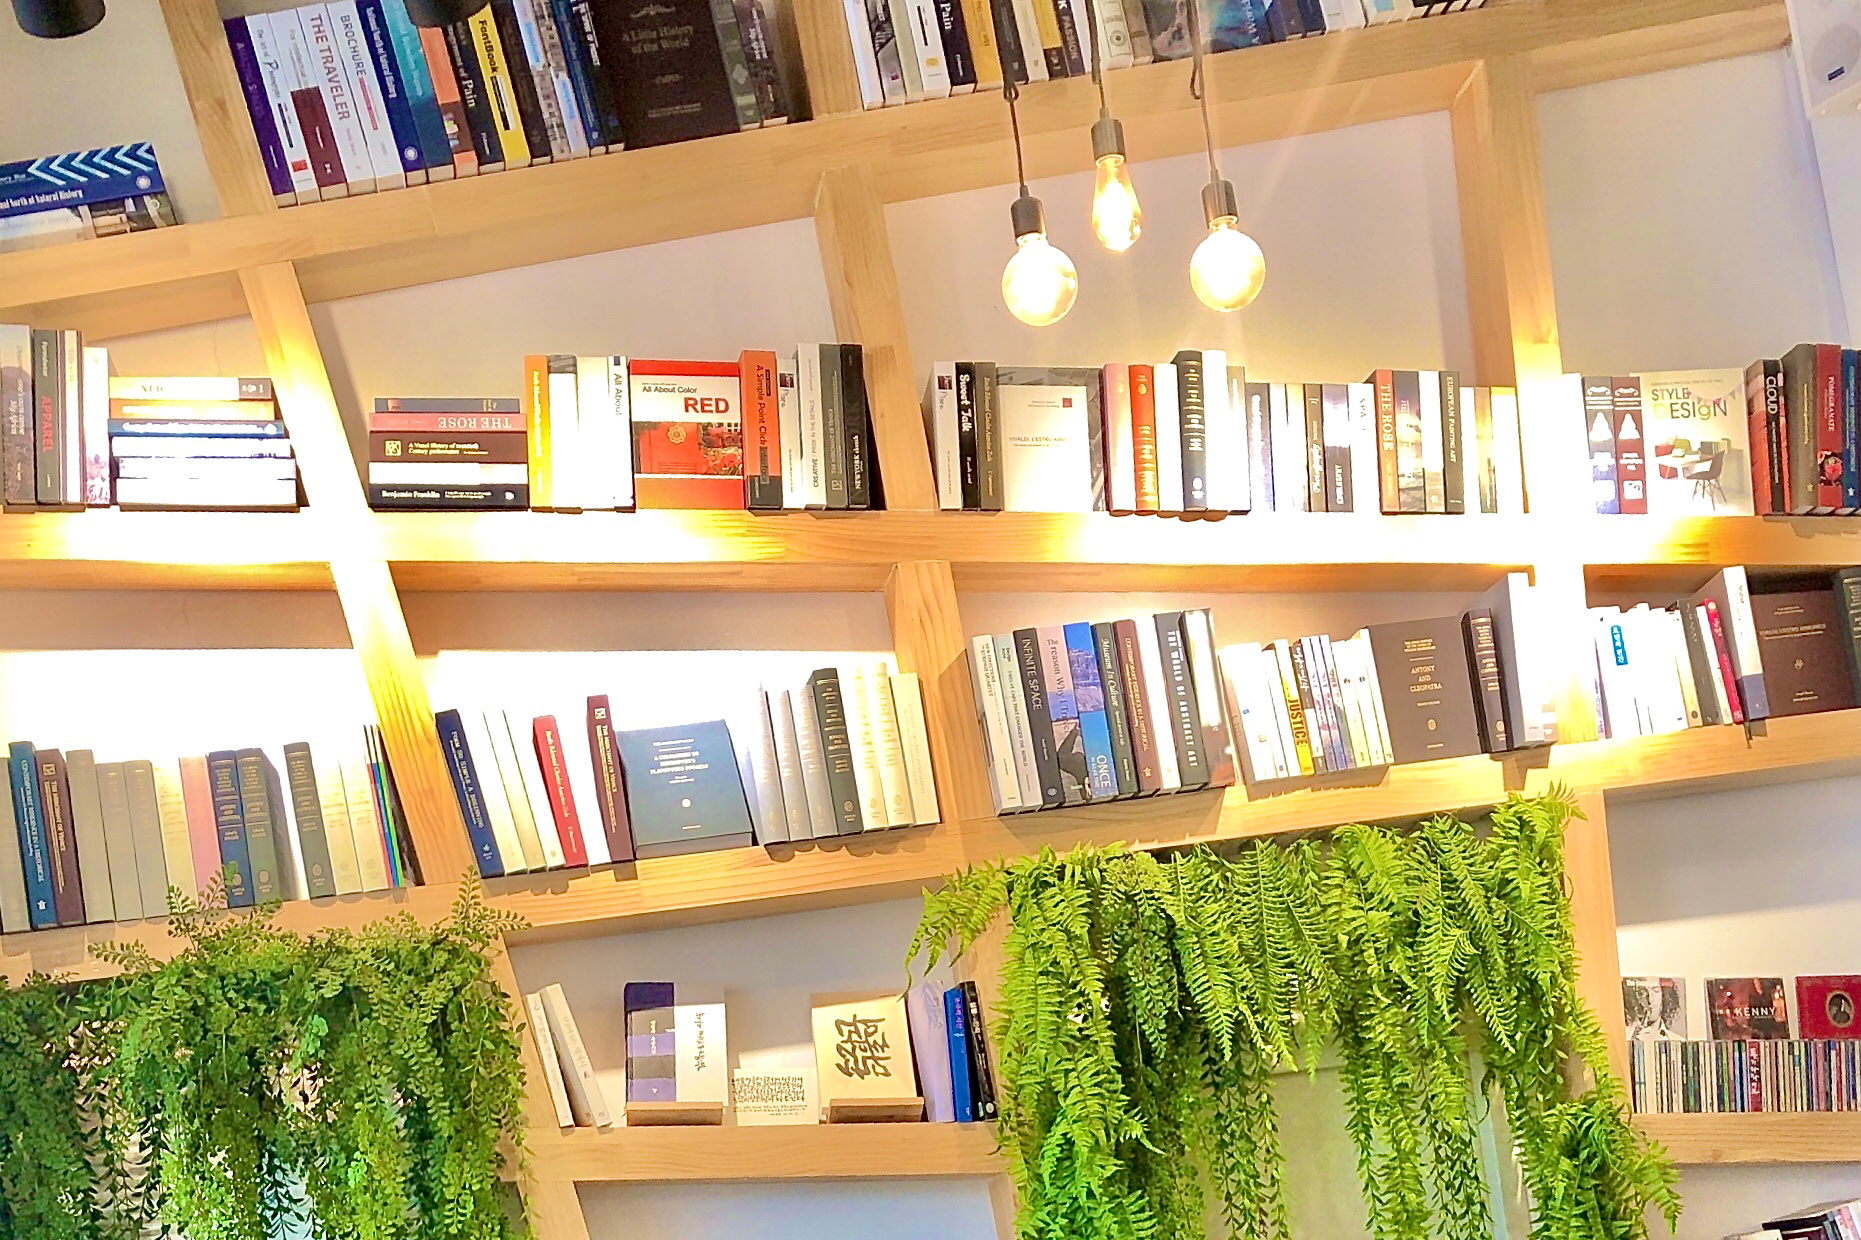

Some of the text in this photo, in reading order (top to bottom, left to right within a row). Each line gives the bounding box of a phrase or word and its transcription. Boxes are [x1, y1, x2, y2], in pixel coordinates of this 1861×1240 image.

[940, 4, 952, 30] Pain
[341, 15, 366, 76] BROCHURE
[1062, 15, 1079, 60] PASSION
[310, 14, 351, 121] THE TRAVELER
[462, 80, 476, 107] Pain
[755, 364, 763, 372] A
[612, 372, 623, 416] All About
[655, 385, 676, 393] About
[677, 386, 697, 394] Color
[753, 373, 765, 401] Simple
[957, 373, 973, 432] Sweet Talk
[1445, 376, 1454, 416] EUROPEAN
[1651, 386, 1690, 401] STYLE
[1764, 375, 1779, 414] CLOUD
[683, 395, 730, 416] RED
[756, 401, 766, 424] Point
[1379, 383, 1394, 451] THE ROSE
[1823, 376, 1839, 431] POMEGRANATE
[41, 395, 54, 453] APPAREL
[437, 416, 512, 429] THE ROSE
[757, 425, 767, 445] Click
[1447, 417, 1456, 449] PAINTING
[810, 457, 820, 488] CREATIVE
[381, 490, 413, 500] Benjamin
[413, 490, 441, 499] Franklin
[1021, 638, 1042, 710] INFINITE SPACE
[1050, 646, 1062, 674] reason
[1100, 637, 1120, 707] Museum In Culture
[1410, 664, 1435, 673] ANTONY
[1051, 676, 1066, 698] Why
[1409, 681, 1442, 692] CLEOPATRA
[1417, 673, 1431, 682] AND
[1167, 630, 1198, 767] THE WORLD OF ABSTRACT ART
[601, 724, 609, 735] THE
[1007, 670, 1015, 688] TWELVE
[1020, 749, 1028, 767] WORLD
[1287, 697, 1308, 746] JUSTICE
[1096, 754, 1111, 788] ONCE
[459, 760, 471, 784] SIMPLE
[469, 792, 484, 829] BEGINNING
[1735, 1007, 1775, 1018] KENNY
